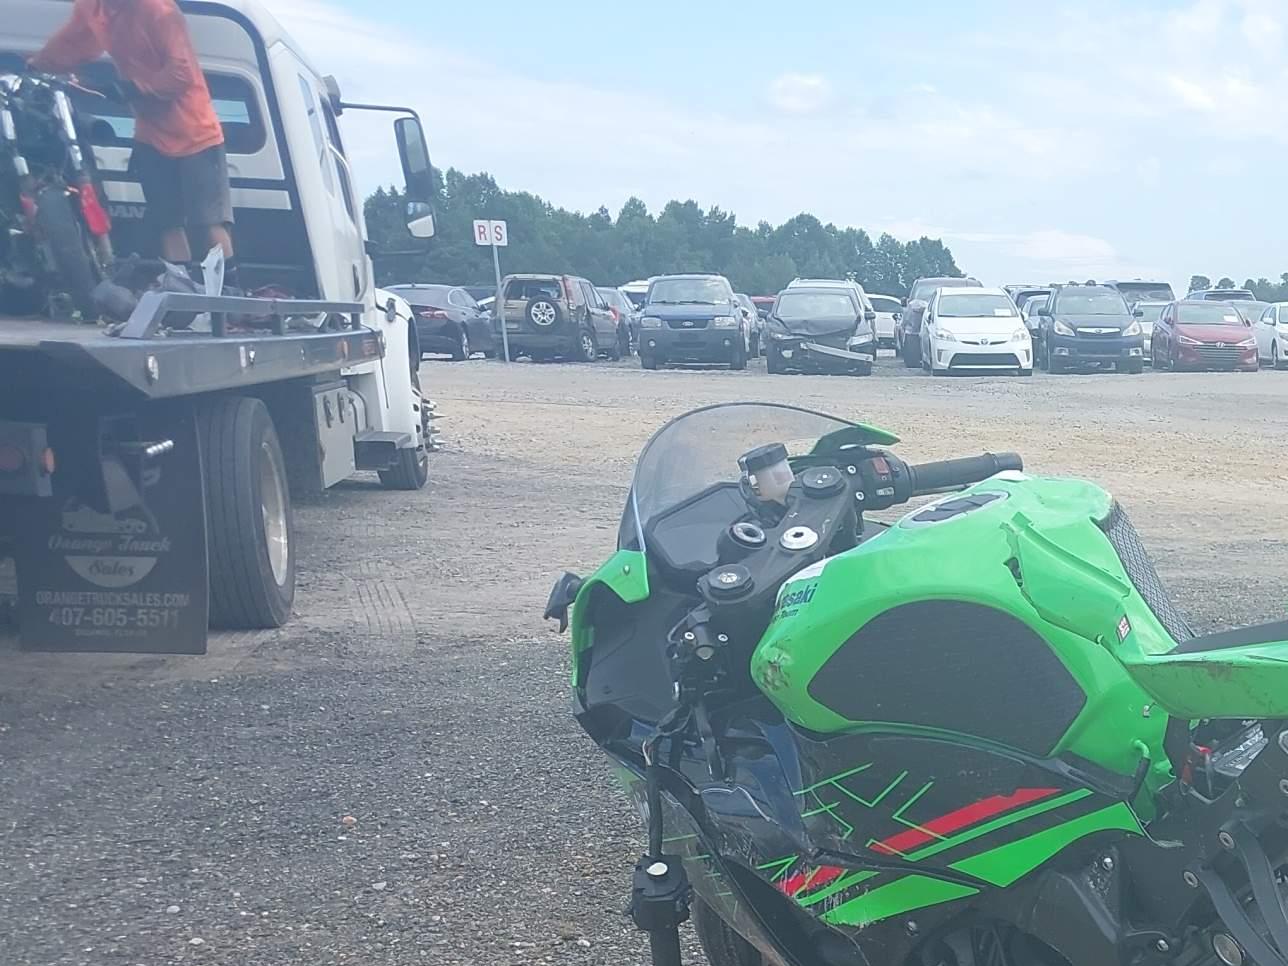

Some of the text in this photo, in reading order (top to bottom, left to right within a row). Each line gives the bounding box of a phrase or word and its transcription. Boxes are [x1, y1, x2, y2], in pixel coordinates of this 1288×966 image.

[477, 224, 503, 241] R S
[88, 560, 136, 577] Sales
[36, 590, 191, 608] ORANGETRUCKSALES.COM
[49, 608, 180, 627] 407-605-5511
